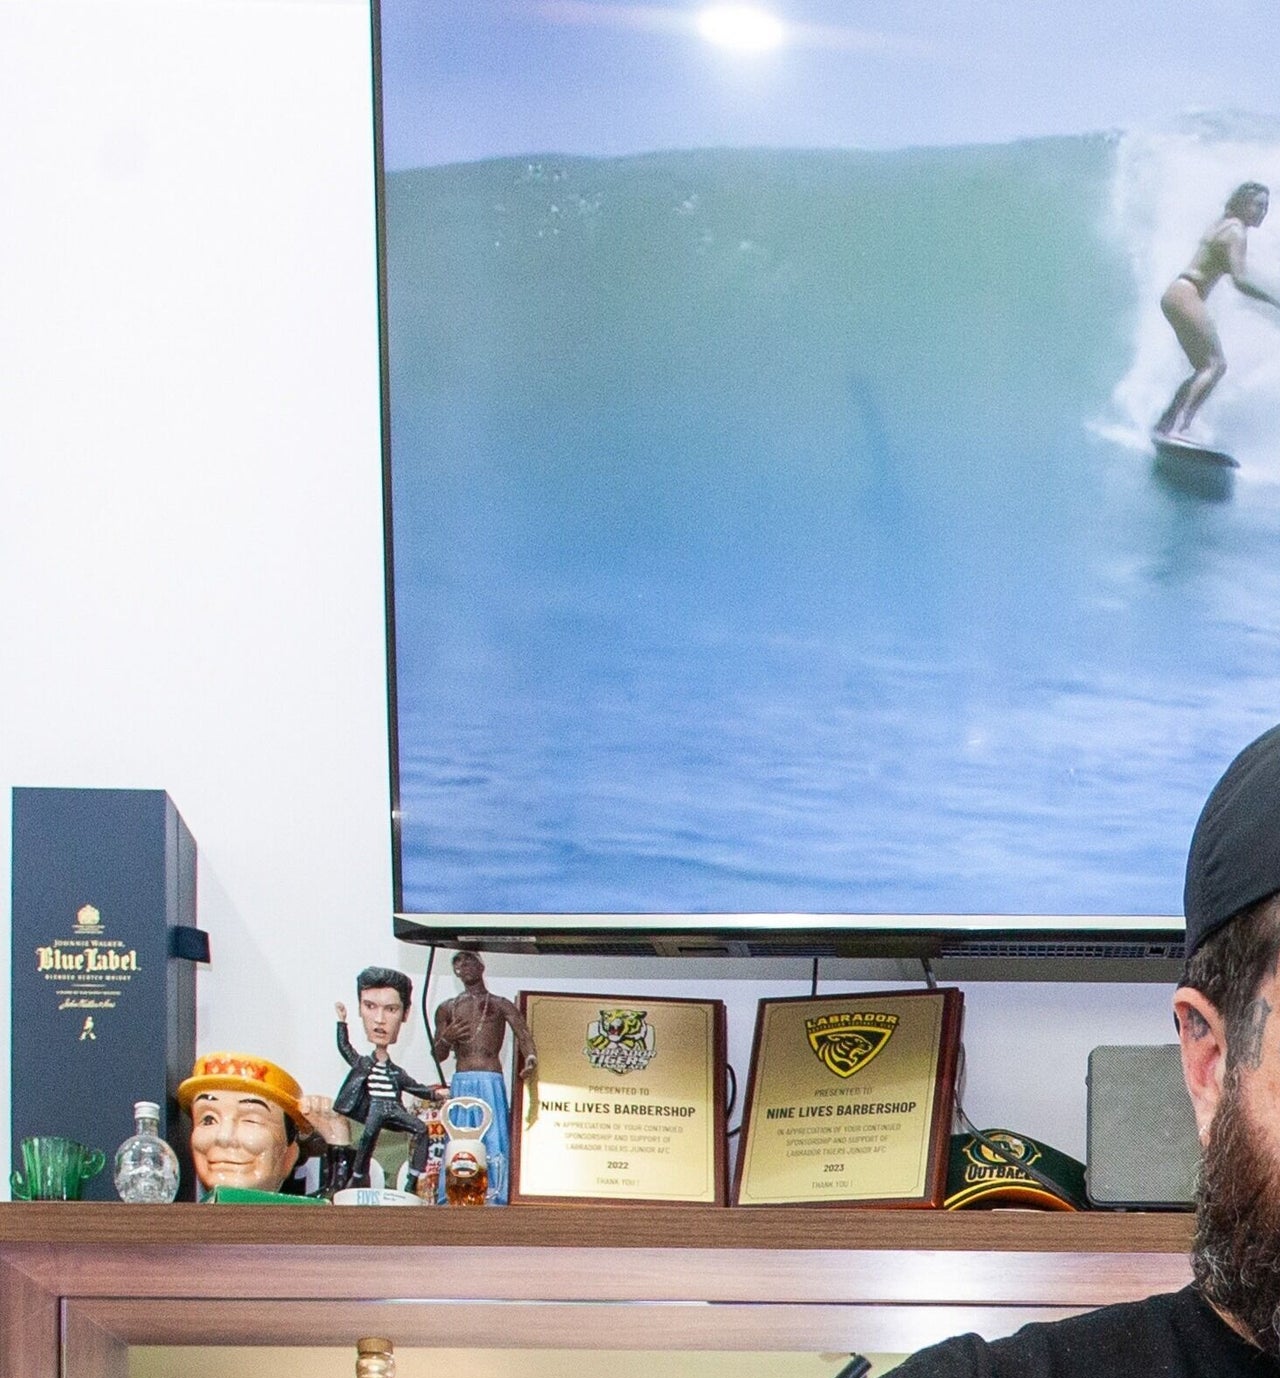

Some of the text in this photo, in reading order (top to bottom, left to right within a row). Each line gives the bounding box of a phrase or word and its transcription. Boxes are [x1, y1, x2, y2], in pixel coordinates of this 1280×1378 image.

[36, 947, 137, 973] Blue Label
[806, 1012, 898, 1028] LABRADOR
[590, 1054, 649, 1066] TIGERS
[588, 1085, 650, 1096] PRESENTED TO
[814, 1087, 863, 1097] PRESENTED
[541, 1101, 696, 1118] NINE LIVES BARBERSHOP
[766, 1102, 917, 1119] NINE LIVES BARBERSHOP
[607, 1161, 629, 1169] 2022
[823, 1163, 845, 1172] 2023
[356, 1189, 380, 1206] ELVIS
